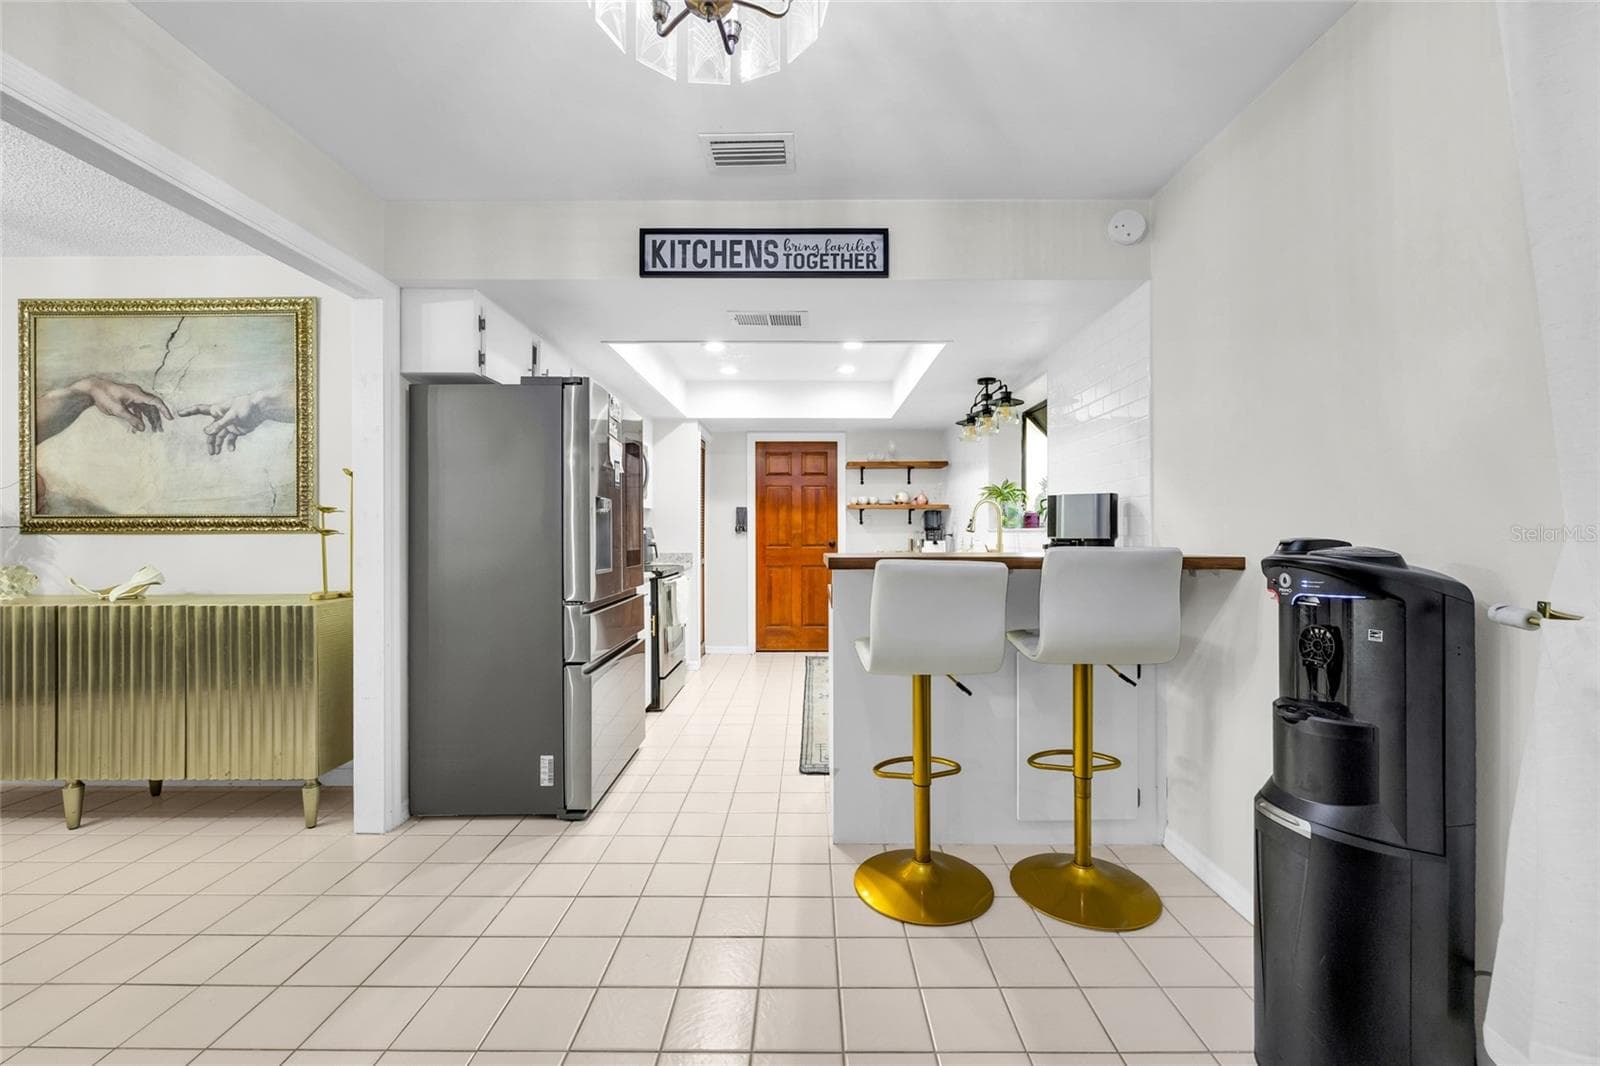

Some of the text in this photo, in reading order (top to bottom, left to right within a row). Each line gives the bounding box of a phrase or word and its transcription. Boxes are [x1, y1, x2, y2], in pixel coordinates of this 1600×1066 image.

[651, 239, 778, 269] KITCHENS
[783, 238, 878, 257] bring families
[783, 253, 877, 269] TOGETHER
